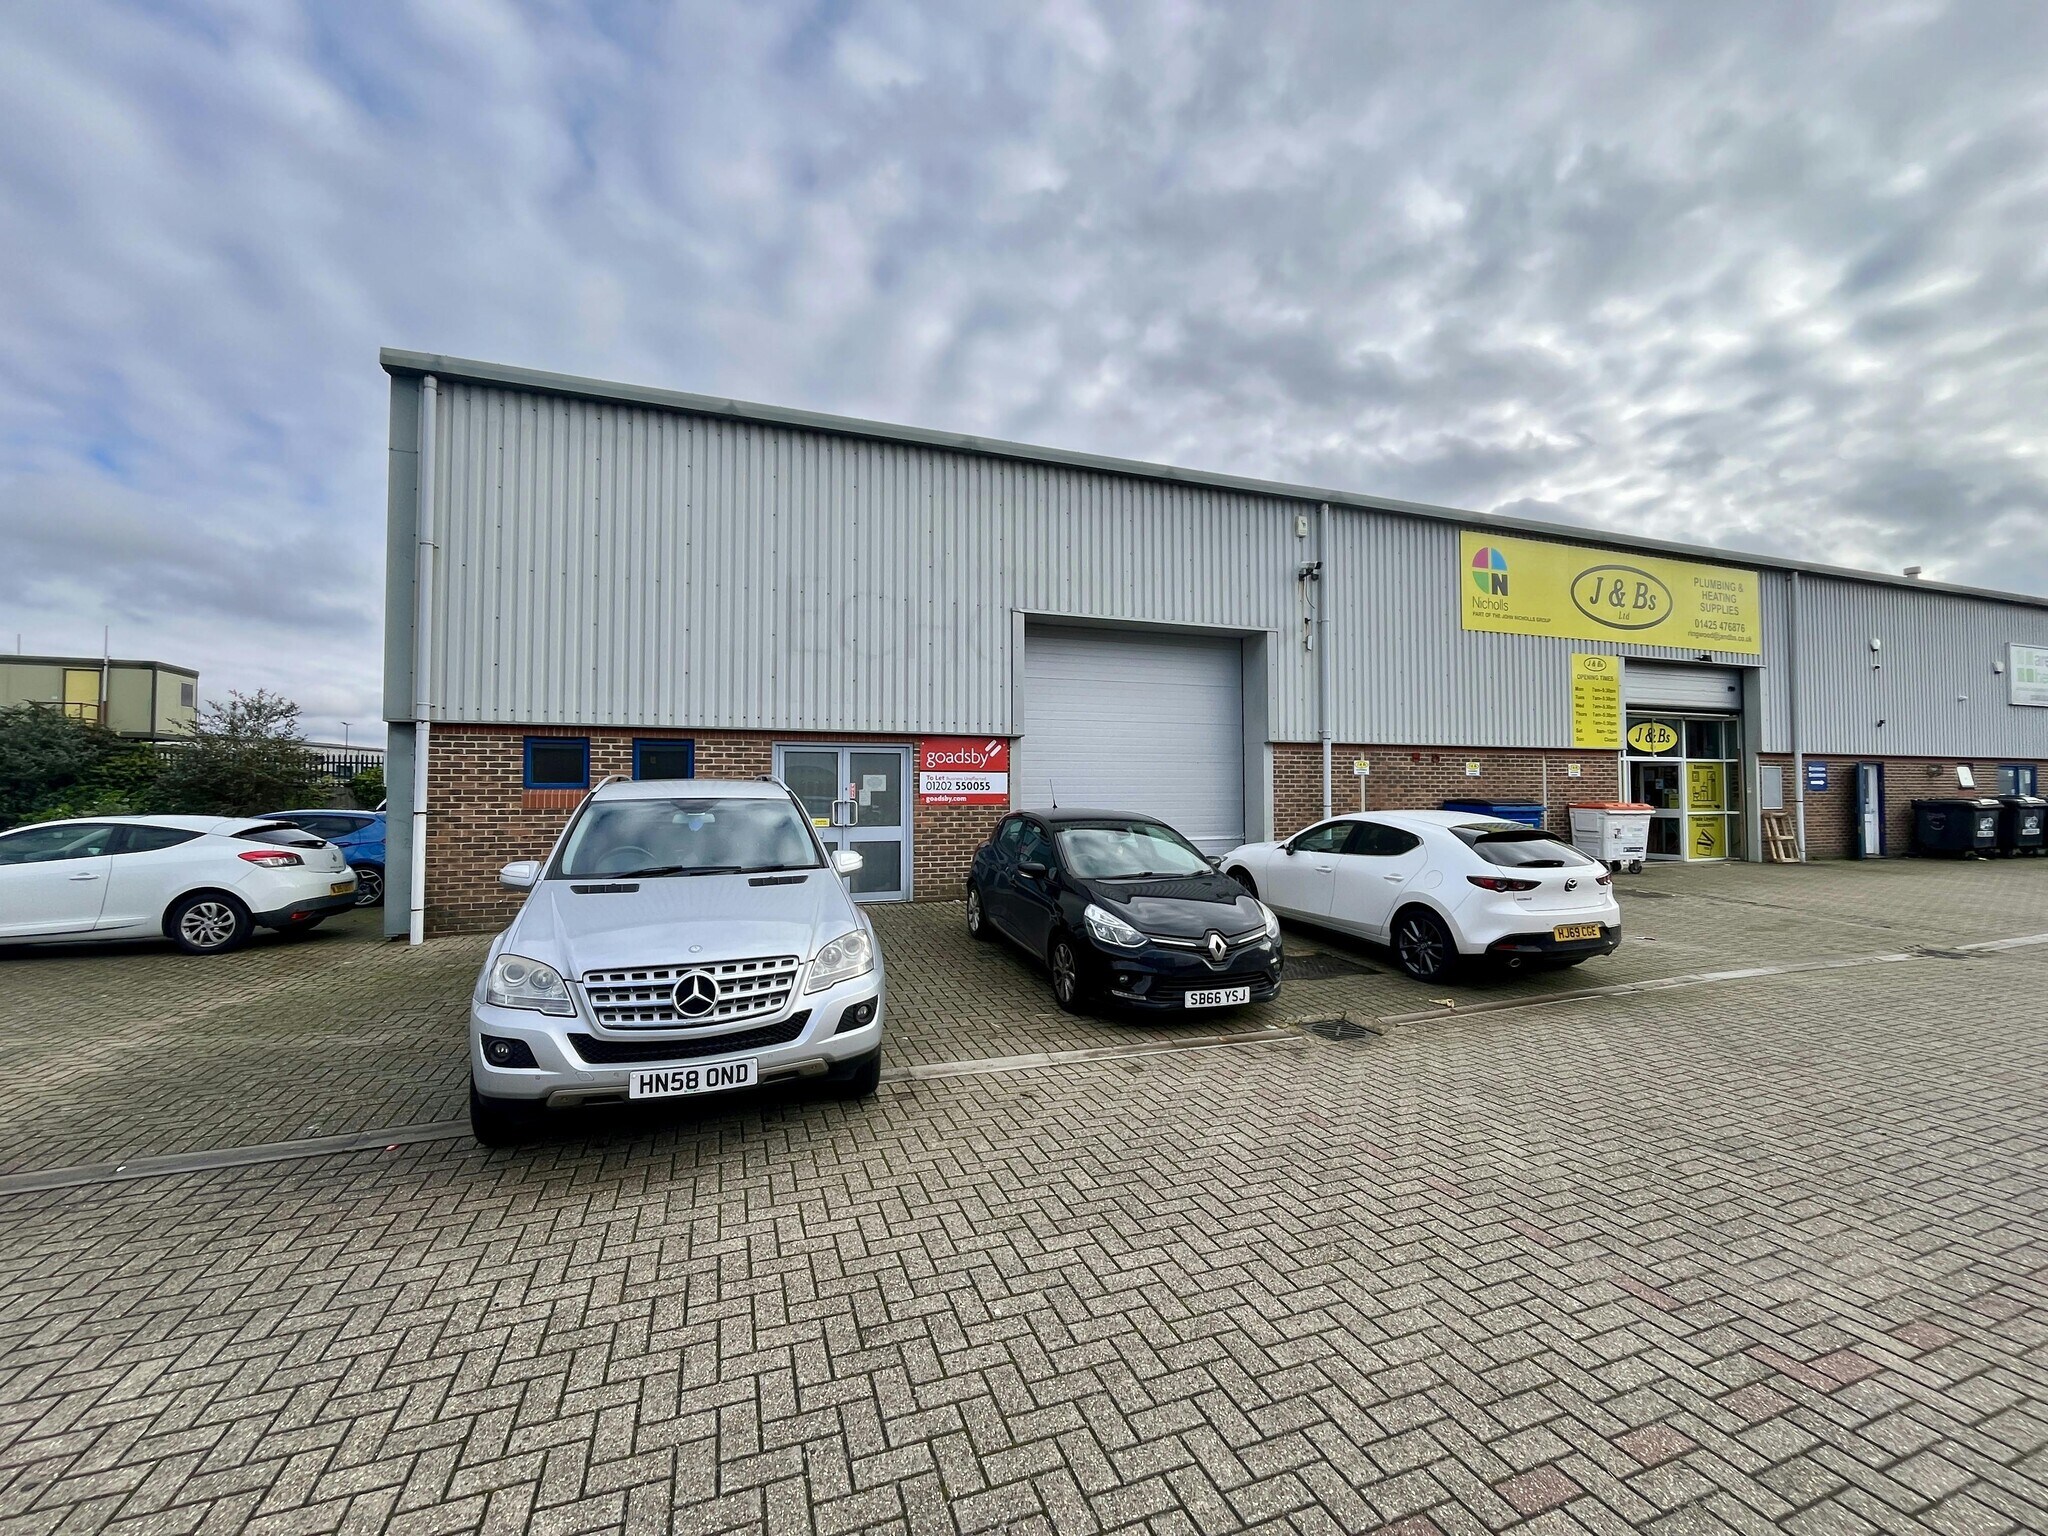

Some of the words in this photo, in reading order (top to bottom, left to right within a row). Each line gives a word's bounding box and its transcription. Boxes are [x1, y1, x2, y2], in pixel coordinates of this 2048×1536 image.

[1693, 577, 1736, 592] PLUMBING
[1737, 583, 1744, 593] &
[1589, 577, 1604, 605] J
[1608, 579, 1626, 608] &
[1632, 582, 1657, 611] Bs
[1701, 591, 1737, 604] HEATING
[1472, 596, 1509, 612] Nicholls
[1700, 602, 1740, 616] SUPPLIES
[1514, 615, 1536, 623] NICHOLLS
[1618, 610, 1631, 621] Ltd
[1694, 618, 1718, 630] 01425
[1719, 621, 1746, 633] 476876
[1635, 727, 1643, 743] J
[1657, 728, 1671, 743] Bs
[926, 748, 988, 768] goadsby
[925, 781, 952, 791] 01202
[955, 781, 991, 791] 550055
[926, 795, 967, 803] goadsby.com
[1557, 927, 1580, 939] HJ69
[1581, 925, 1597, 937] CGE
[1190, 991, 1222, 1006] SB66
[1225, 989, 1246, 1003] YSJ
[639, 1070, 699, 1095] HN58
[706, 1063, 748, 1088] OND
